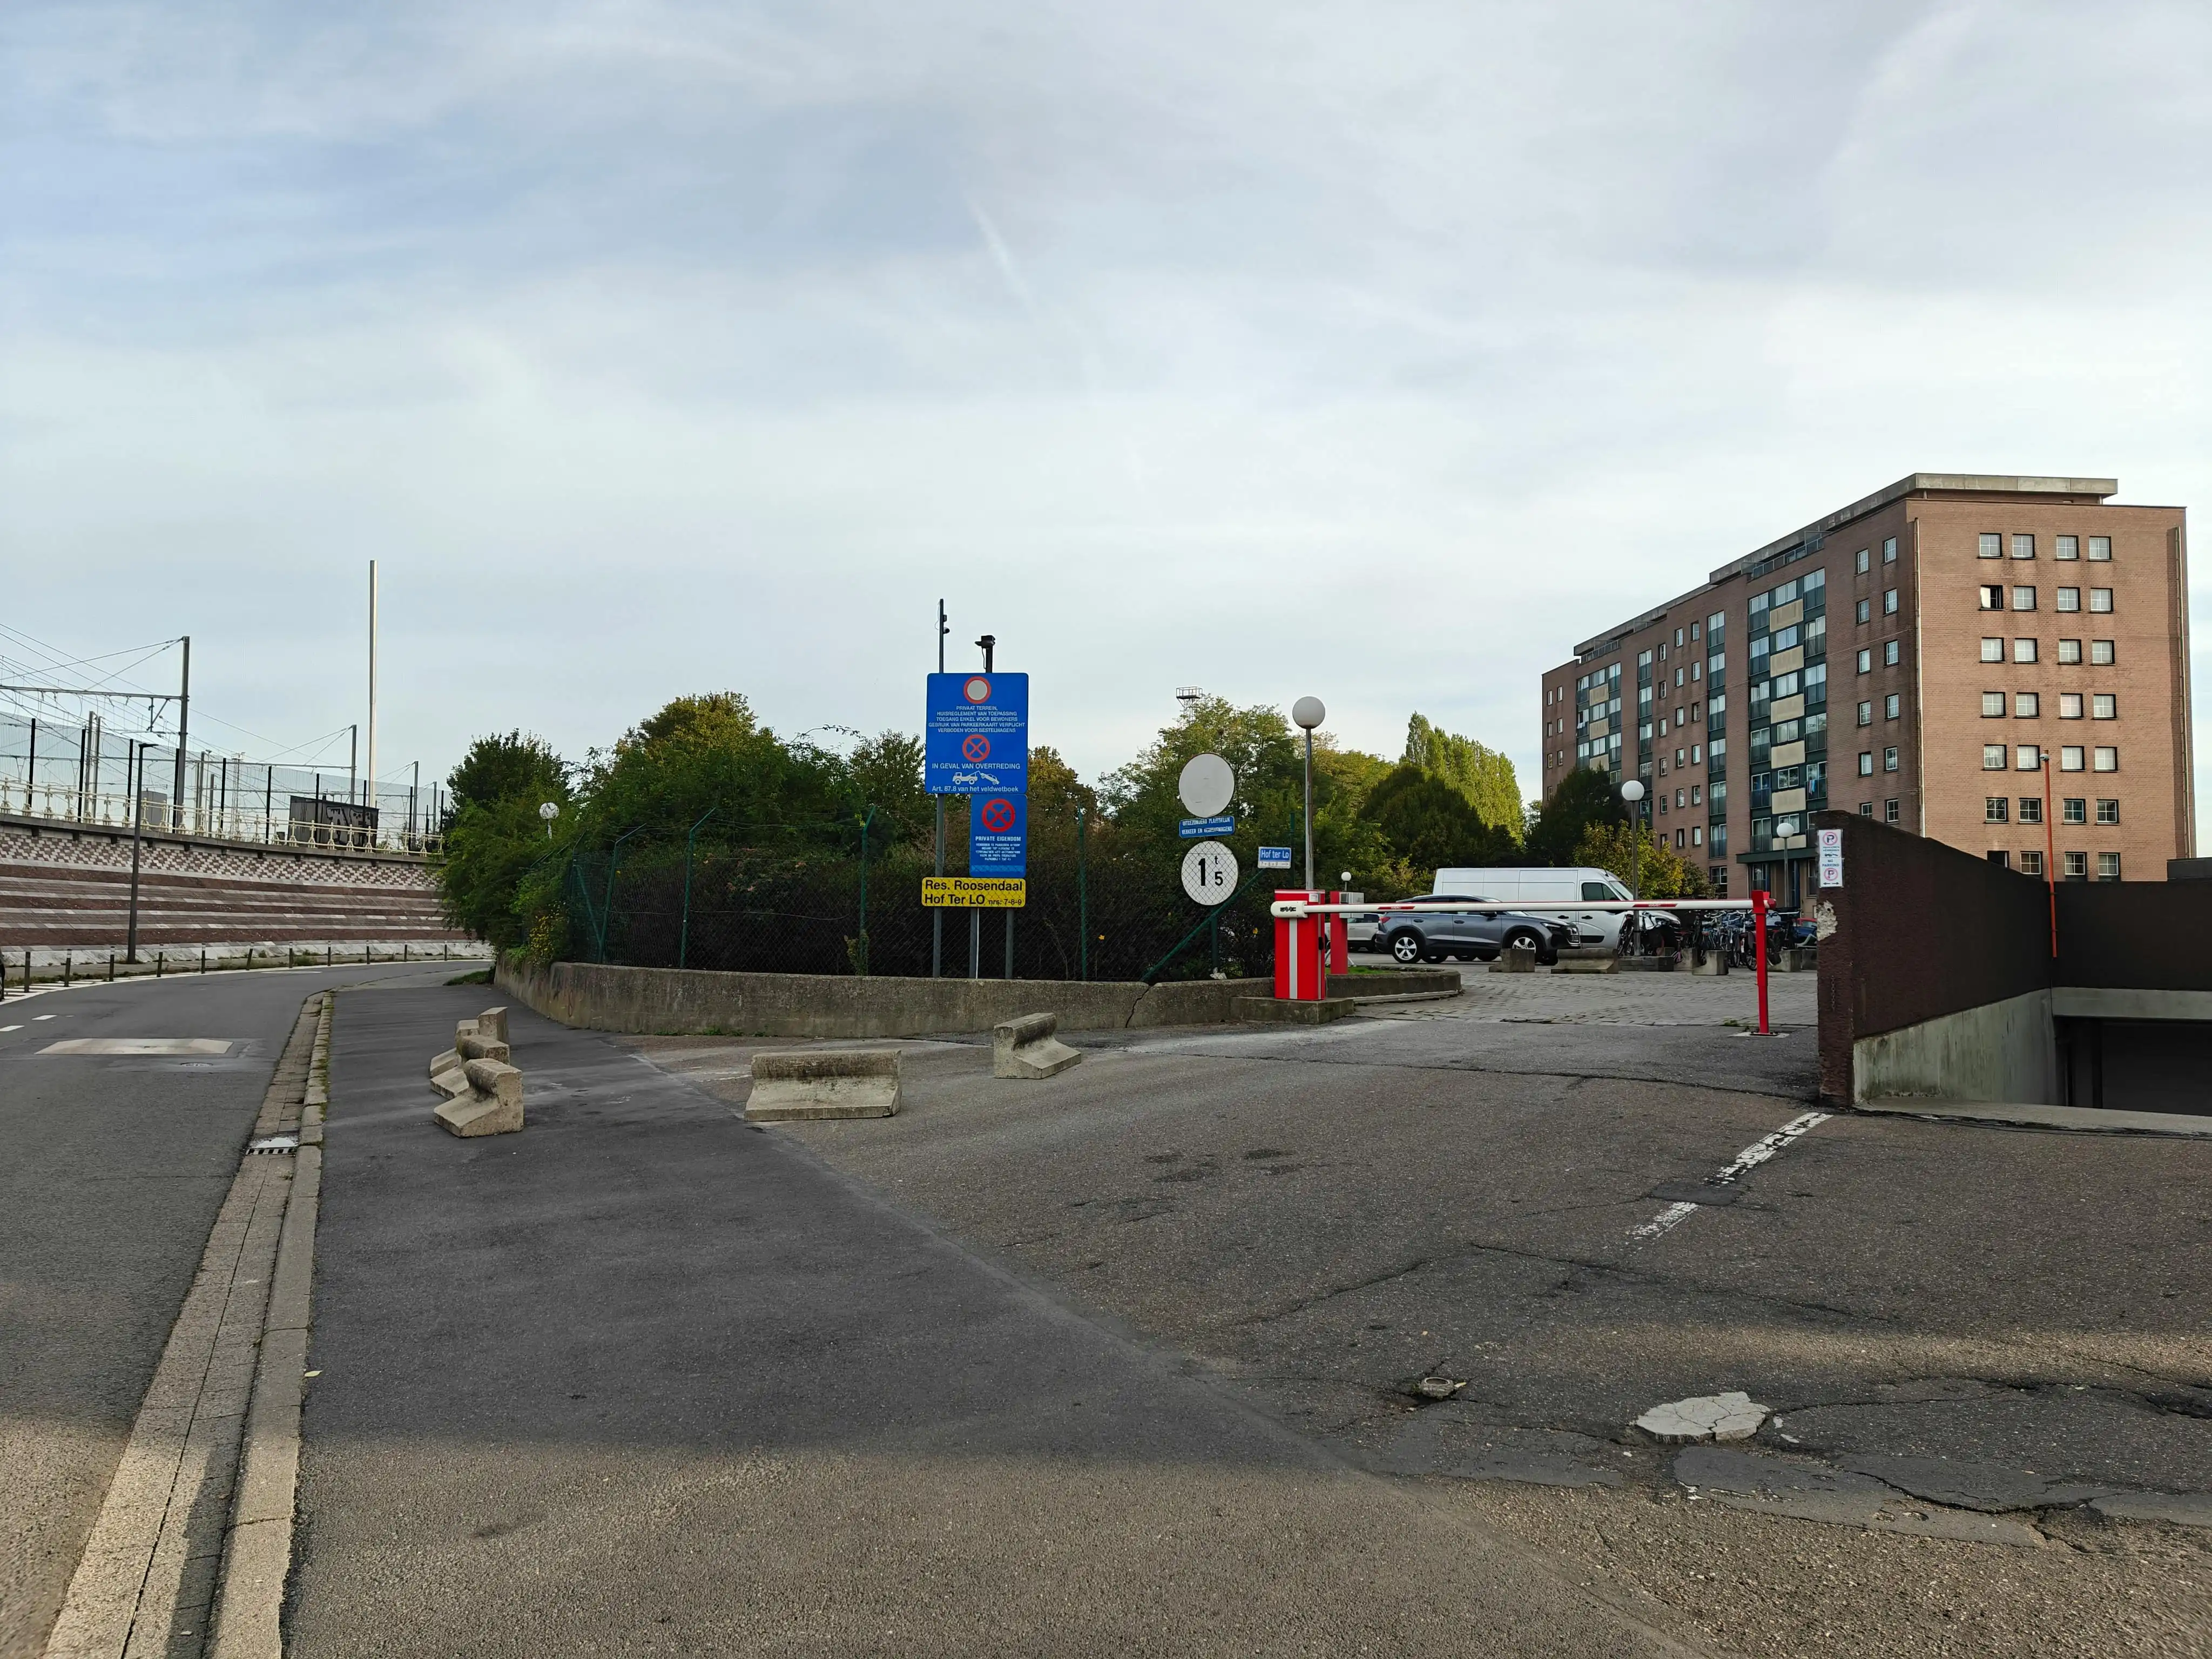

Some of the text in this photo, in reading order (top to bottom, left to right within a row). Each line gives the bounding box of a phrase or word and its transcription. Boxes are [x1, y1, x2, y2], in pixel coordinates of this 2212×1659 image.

[1261, 849, 1289, 858] Hof ter Lo
[1215, 855, 1218, 865] t
[1198, 858, 1223, 886] 1 5
[925, 880, 1022, 891] Res. Roosendaal
[925, 894, 945, 904] Hof
[948, 894, 966, 904] Ter
[969, 894, 985, 905] LO
